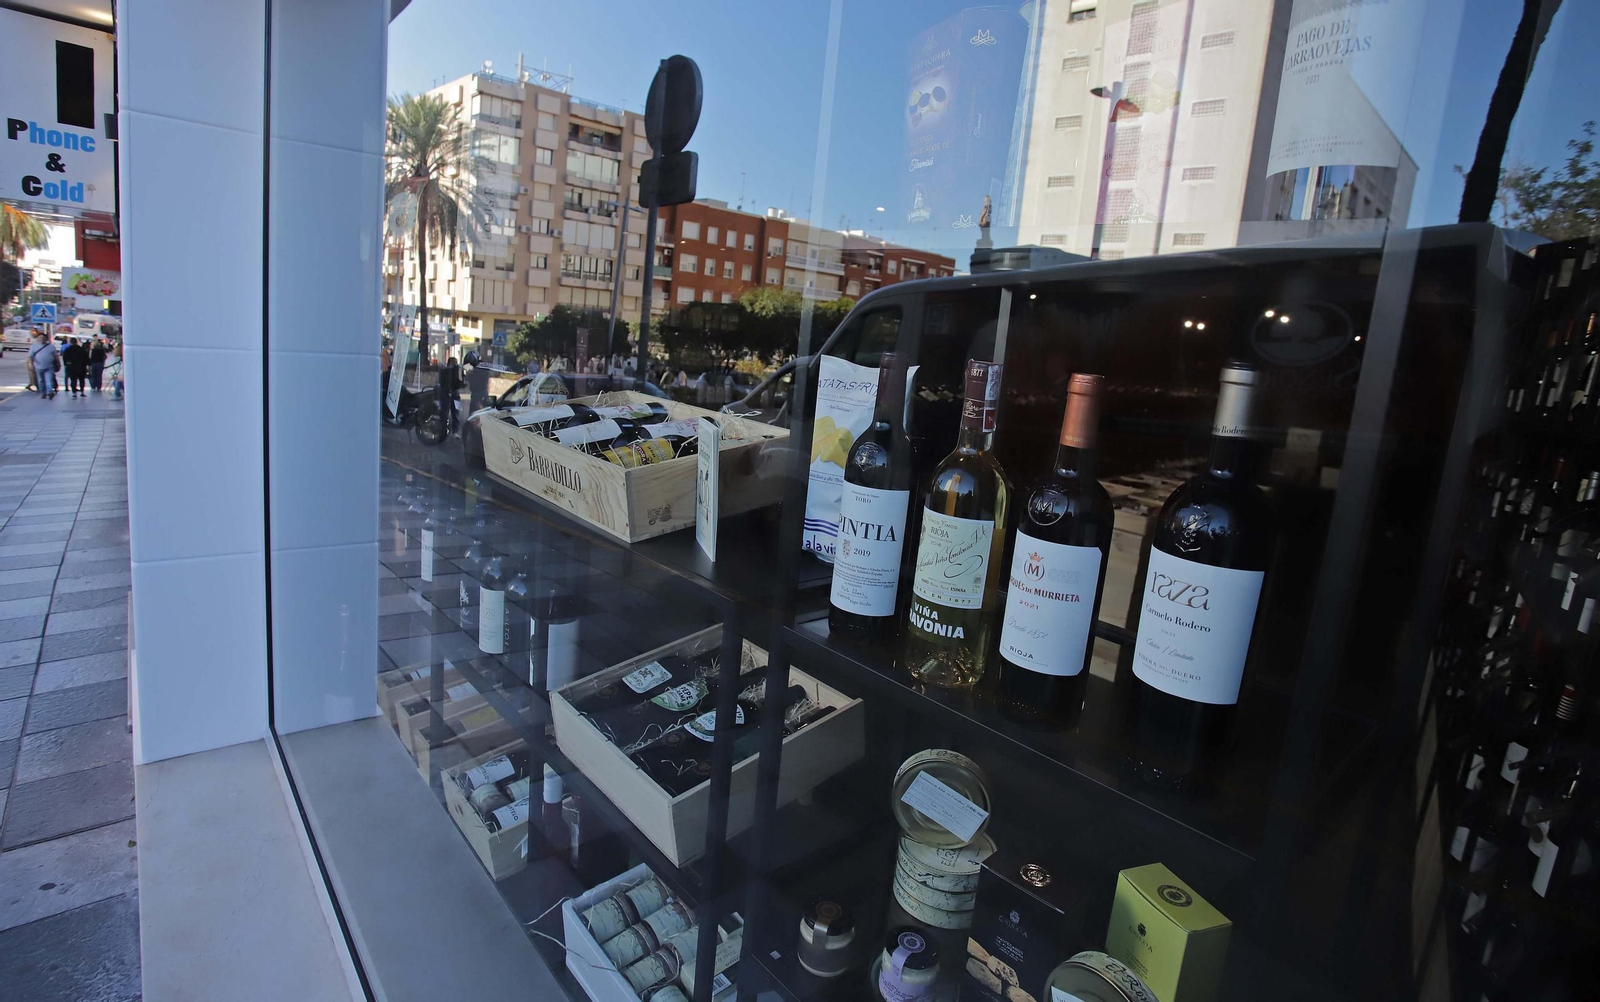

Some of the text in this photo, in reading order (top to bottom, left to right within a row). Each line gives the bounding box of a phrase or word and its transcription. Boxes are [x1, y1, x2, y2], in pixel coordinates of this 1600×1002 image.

[1296, 19, 1351, 48] PAGO DE
[7, 118, 96, 152] Phone
[45, 153, 66, 173] &
[21, 175, 84, 203] Gold
[526, 445, 582, 494] BARBADILLO
[855, 496, 872, 504] TORO
[930, 526, 950, 539] RIOJA
[853, 547, 871, 557] 2019
[1033, 587, 1080, 603] MURRIETA
[914, 602, 939, 620] VIÑA
[1019, 599, 1039, 610] 2021
[1145, 602, 1211, 634] Carmelo Rodero
[1009, 644, 1034, 660] RIOJA
[1171, 667, 1201, 681] DUERO
